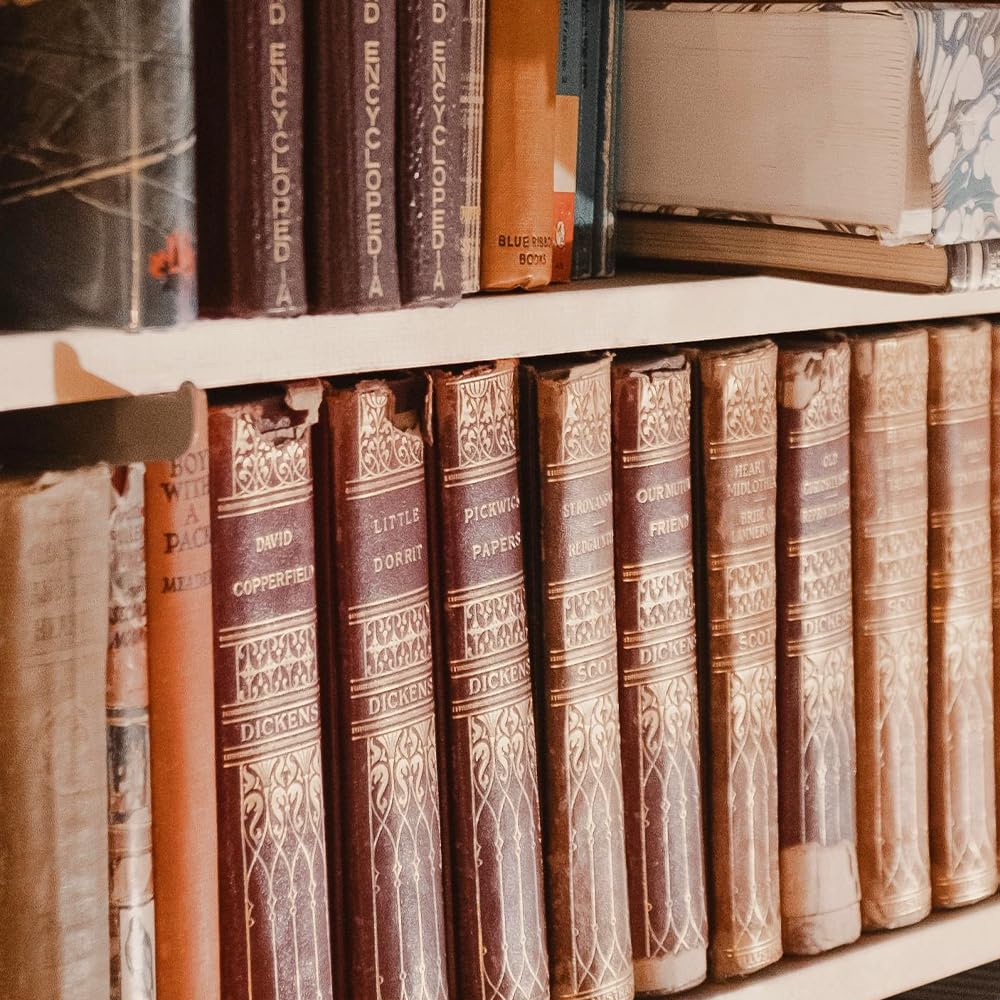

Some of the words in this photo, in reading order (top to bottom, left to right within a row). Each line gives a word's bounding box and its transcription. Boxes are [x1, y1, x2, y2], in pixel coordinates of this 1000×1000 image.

[269, 42, 293, 307] ENCYCLOPEDIA
[364, 40, 384, 299] ENCYCLOPEDIA
[432, 40, 447, 291] ENCYCLOPEDIA
[498, 234, 530, 248] BLUE
[372, 507, 420, 535] LITTLE
[255, 530, 293, 553] DAVID
[373, 544, 423, 573] DORRIT
[472, 531, 521, 561] PAPERS
[232, 564, 315, 598] COPPERFIELD
[738, 627, 776, 650] SCOT
[468, 657, 531, 696] DICKENS
[368, 676, 434, 716] DICKENS
[240, 702, 319, 743] DICKENS
